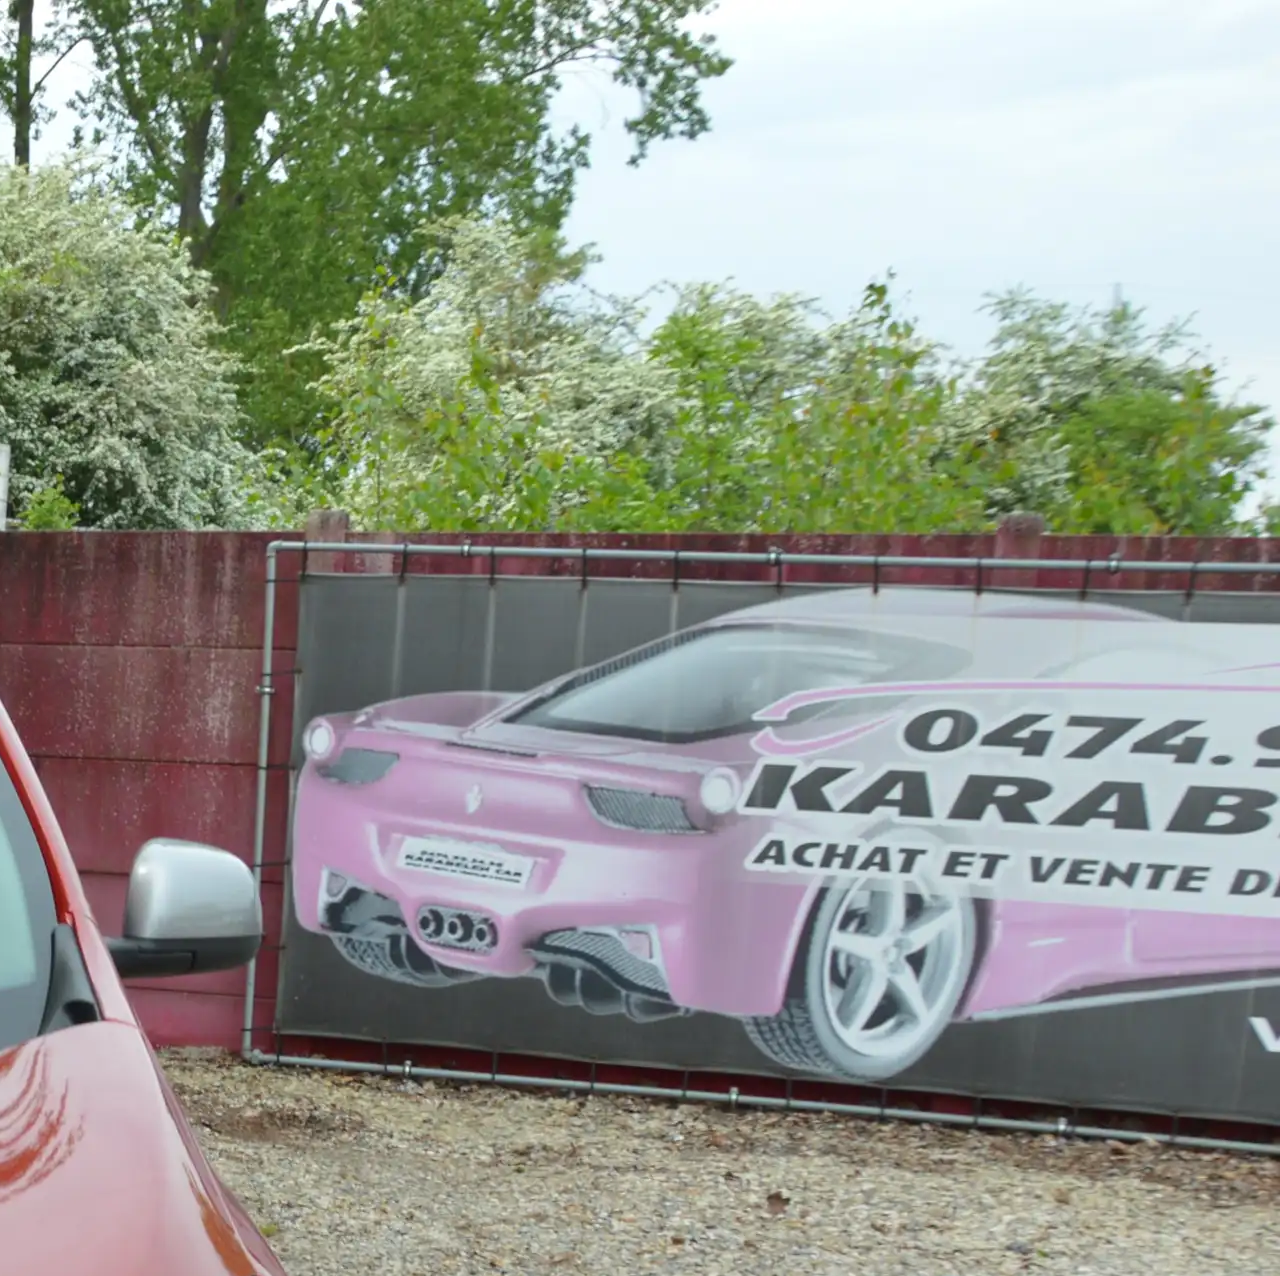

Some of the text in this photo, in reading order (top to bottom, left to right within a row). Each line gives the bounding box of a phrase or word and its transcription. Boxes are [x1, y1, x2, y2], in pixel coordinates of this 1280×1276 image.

[744, 764, 1280, 838] KARAB
[753, 839, 926, 873] ACHAT
[942, 852, 1010, 879] ET
[1031, 856, 1210, 893] VENTE
